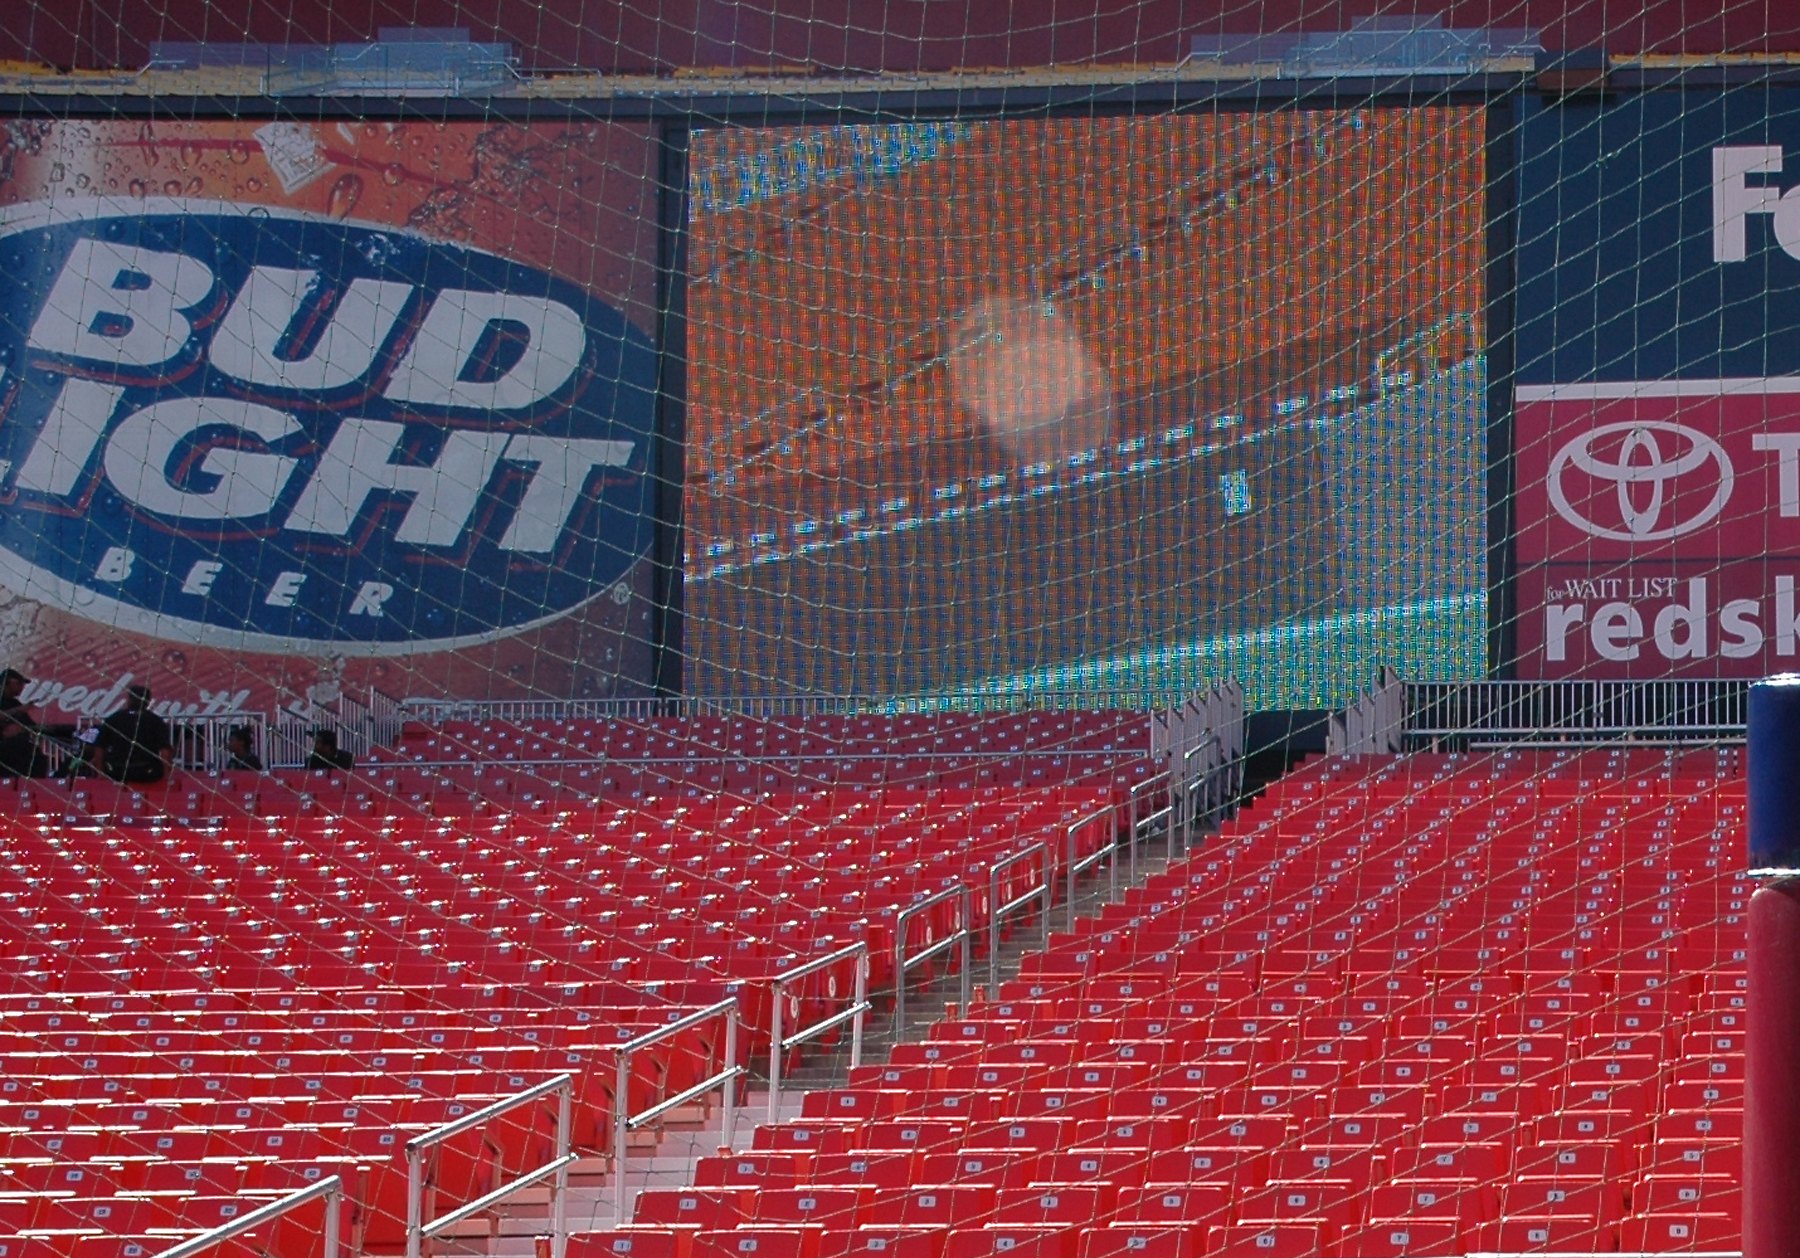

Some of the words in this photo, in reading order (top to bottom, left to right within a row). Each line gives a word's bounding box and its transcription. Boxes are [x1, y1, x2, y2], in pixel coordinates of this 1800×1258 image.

[28, 238, 586, 410] BUD
[0, 366, 634, 554] IGHT
[96, 547, 393, 617] BEER
[1565, 579, 1622, 599] WAIT
[1628, 577, 1678, 598] LIST
[14, 672, 134, 718] wed
